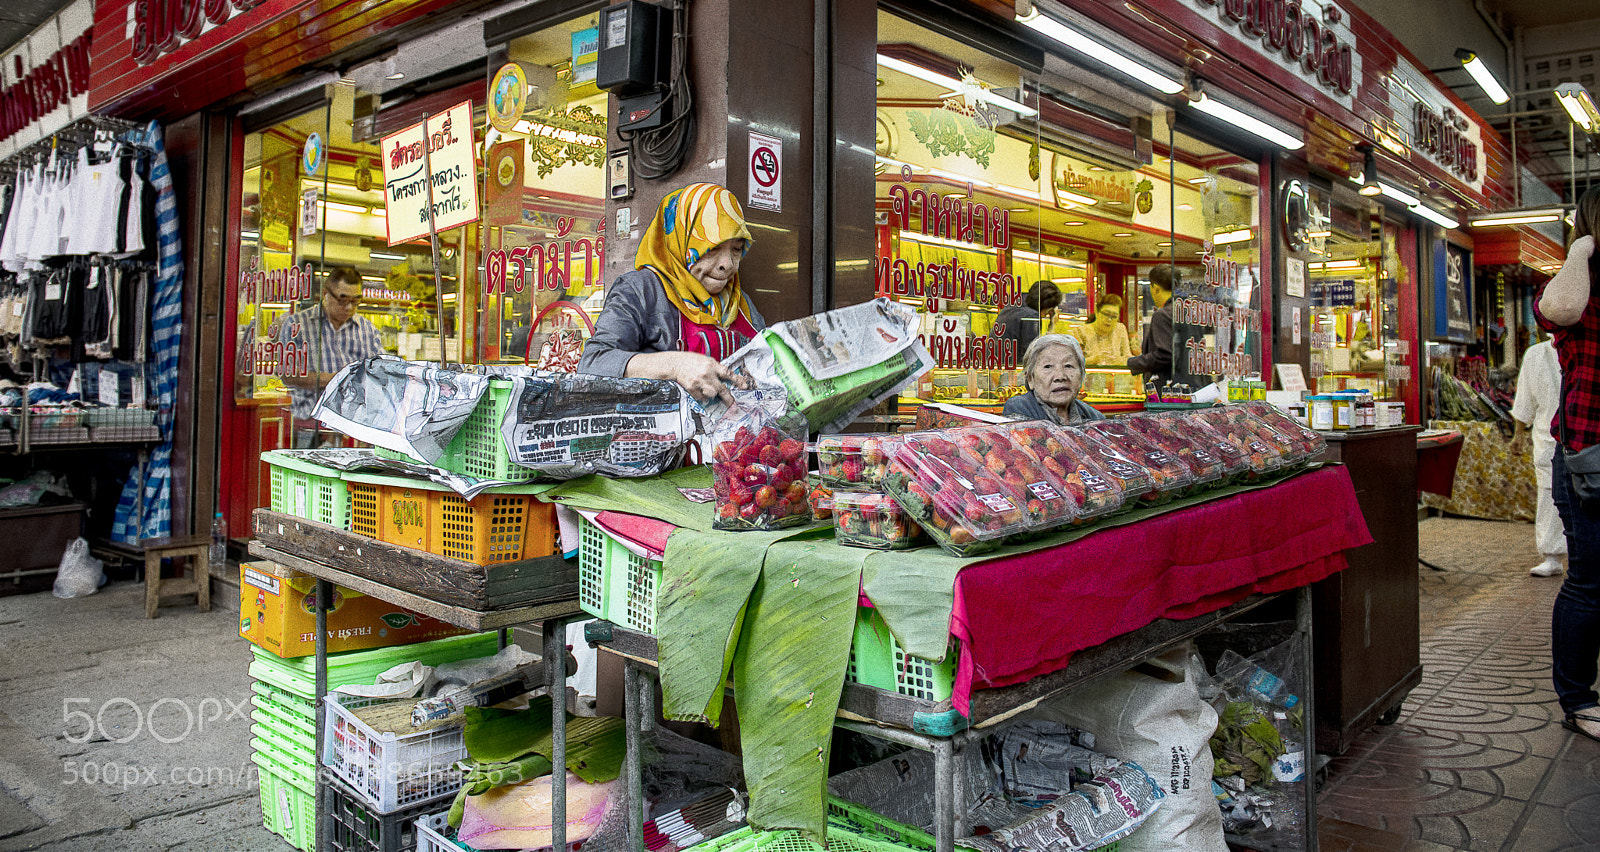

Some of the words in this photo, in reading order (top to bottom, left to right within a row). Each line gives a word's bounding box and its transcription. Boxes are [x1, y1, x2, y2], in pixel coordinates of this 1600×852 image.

[390, 111, 459, 170] สตรอบอรี่..
[386, 164, 468, 201] โครงกาหลวง..
[888, 164, 1010, 250] จำหน่าย
[875, 255, 1023, 314] ทองรูปพรรณ
[300, 630, 336, 643] ALE
[338, 626, 372, 638] FRESH
